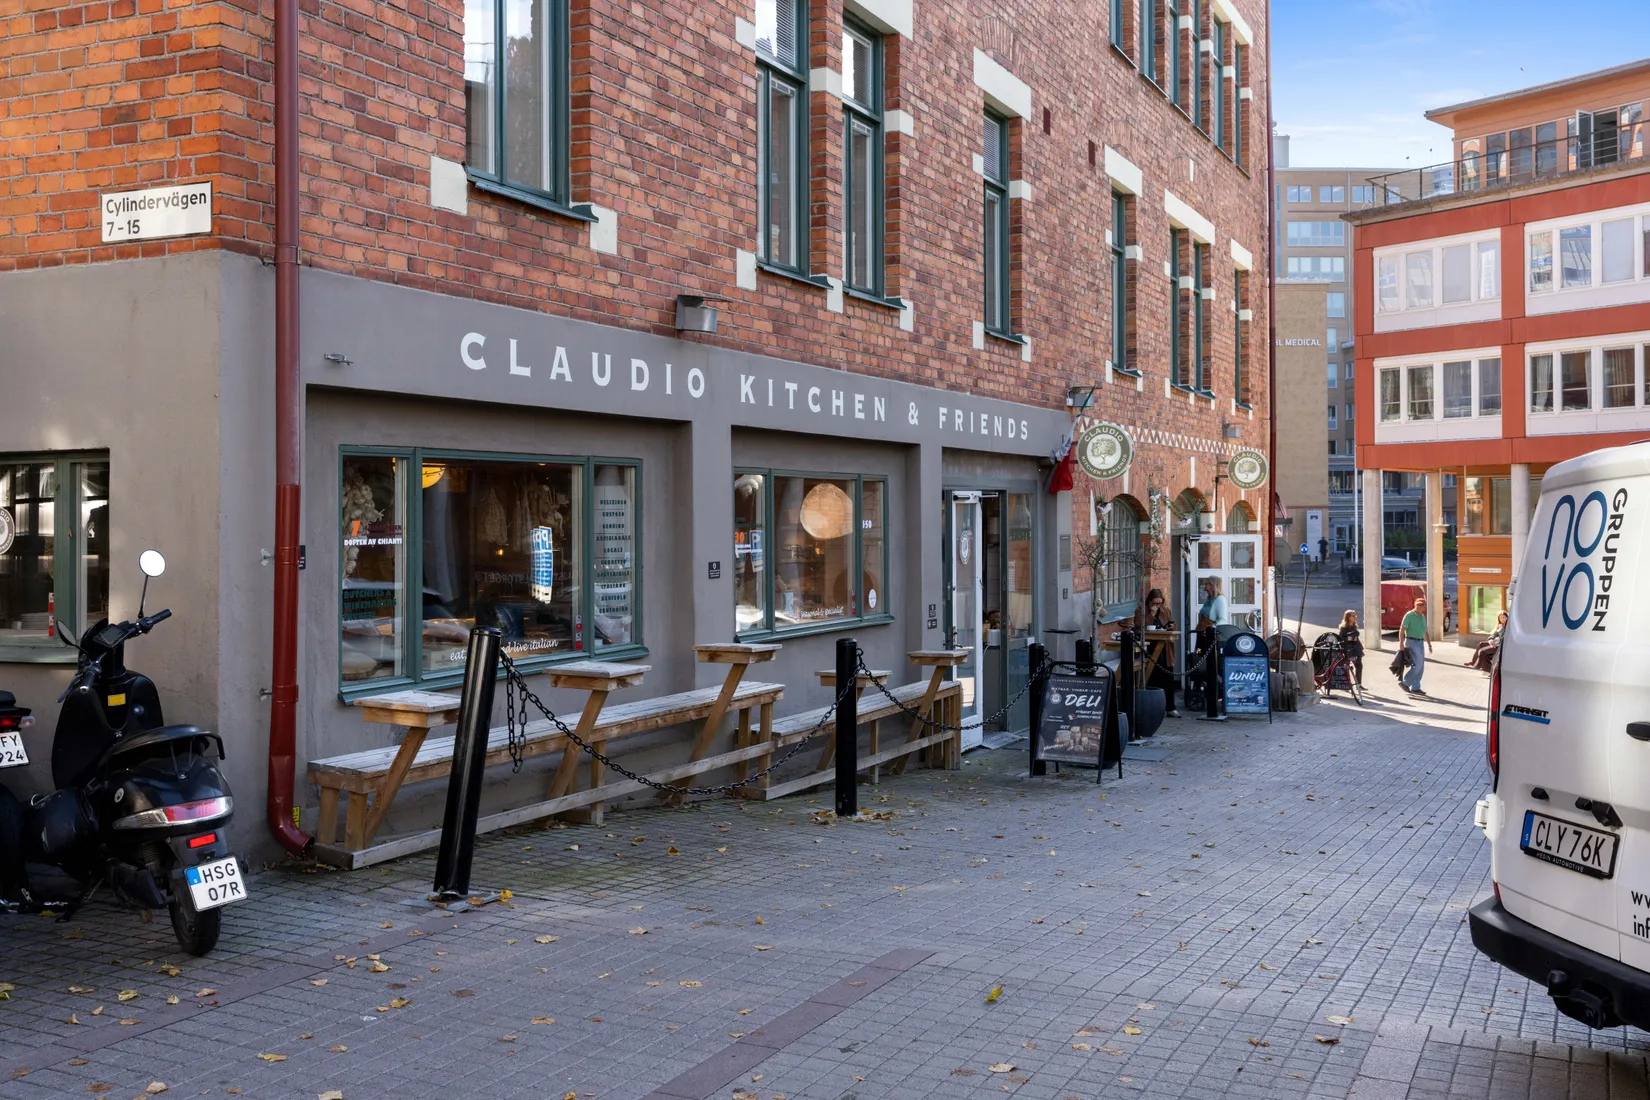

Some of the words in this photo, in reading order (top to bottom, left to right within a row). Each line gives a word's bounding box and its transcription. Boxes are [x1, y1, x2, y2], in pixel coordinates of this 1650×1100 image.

[106, 191, 207, 215] Cylindervägen
[460, 332, 705, 398] CLAUDIO
[740, 374, 886, 422] KITCHEN
[908, 401, 919, 426] &
[939, 406, 1028, 440] FRIENDS
[1084, 427, 1124, 442] CLAUDIO
[1081, 455, 1101, 475] KITCHEN
[1108, 454, 1128, 475] FRIENDS
[1233, 452, 1263, 464] CLAUDIO
[1591, 487, 1628, 632] GRUPPEN
[513, 640, 530, 654] live
[530, 637, 559, 651] italian
[1228, 671, 1265, 682] LUNCH
[1064, 693, 1101, 708] DELI
[1535, 820, 1567, 854] CLY
[1569, 829, 1606, 867] 76K
[202, 862, 236, 883] HSG
[1552, 858, 1584, 873] AUTOMOTIVE
[208, 881, 241, 902] 07R
